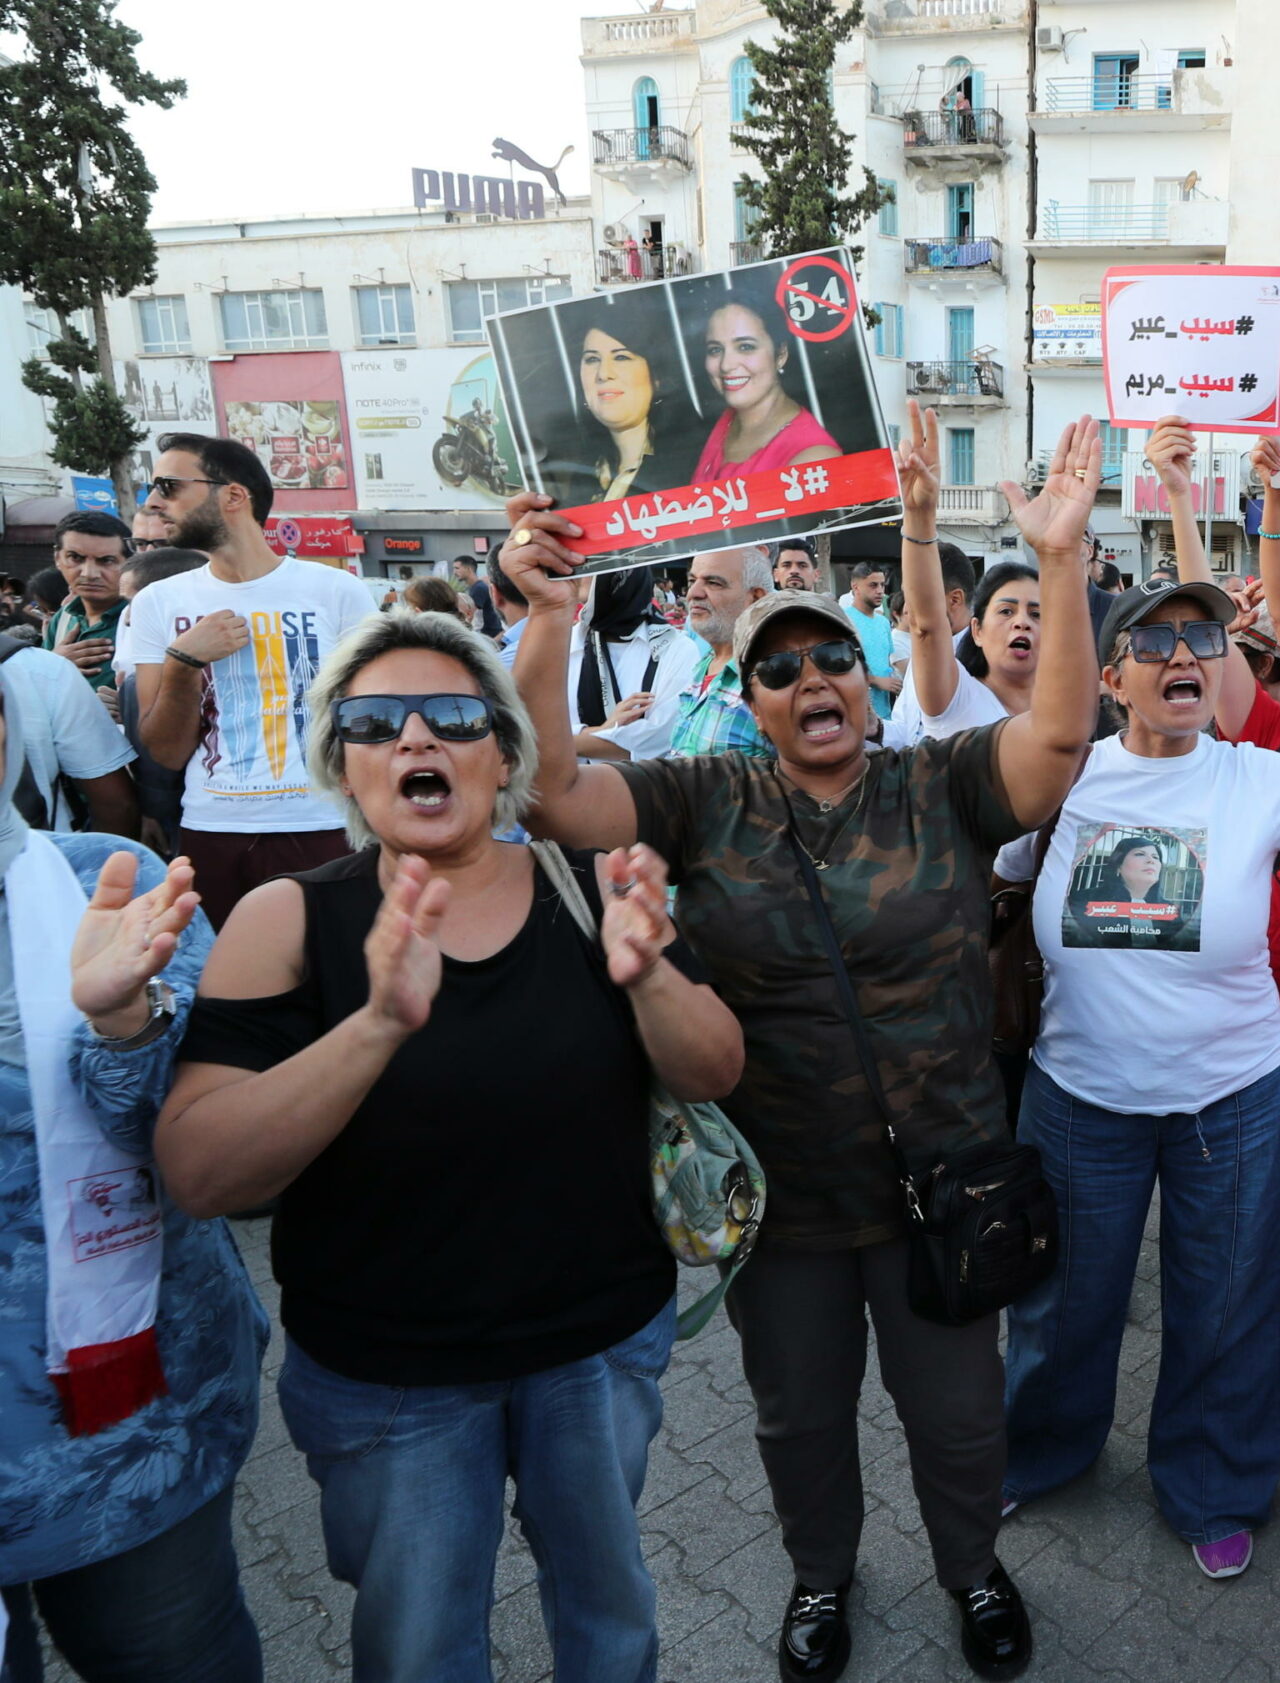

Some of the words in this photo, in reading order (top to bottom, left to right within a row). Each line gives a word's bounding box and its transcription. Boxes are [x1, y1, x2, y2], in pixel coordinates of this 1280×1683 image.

[412, 167, 545, 219] PUMA
[788, 276, 847, 321] 54
[385, 538, 421, 551] Orange
[1097, 922, 1129, 935] الشعب
